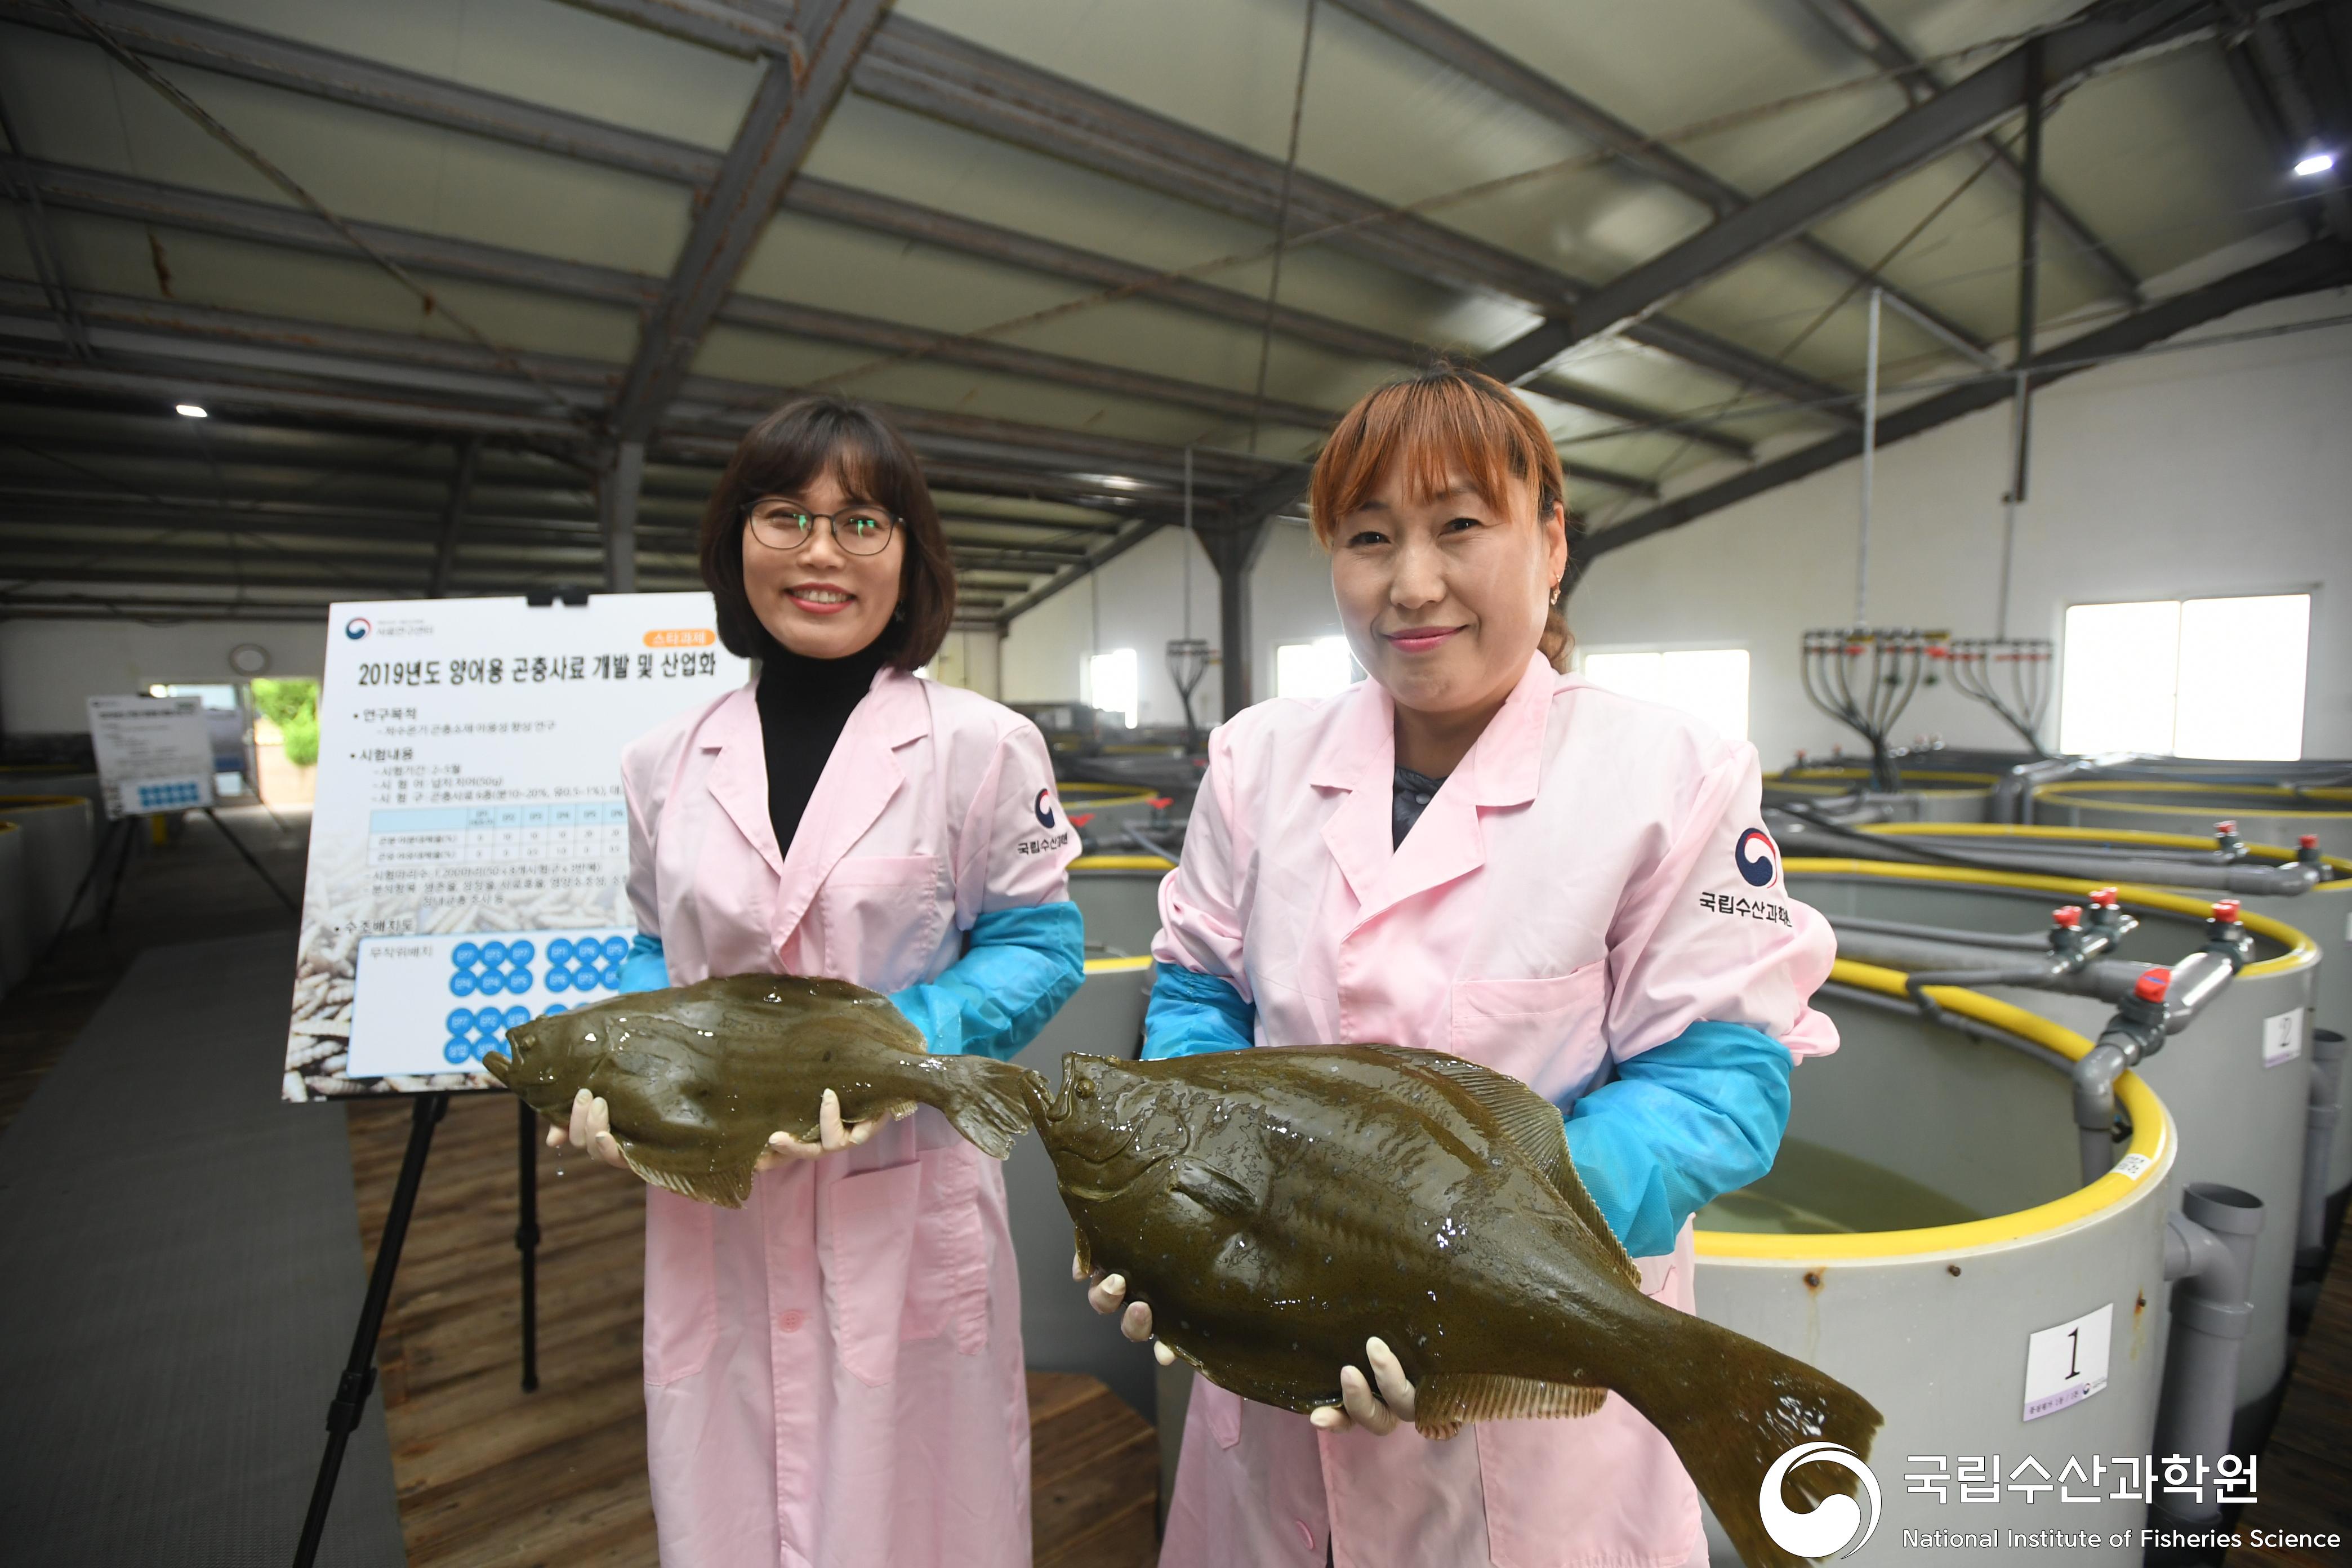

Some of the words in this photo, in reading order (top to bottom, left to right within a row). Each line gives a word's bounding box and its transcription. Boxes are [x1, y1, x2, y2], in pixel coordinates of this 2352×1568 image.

[653, 632, 705, 645] 스타과제
[358, 660, 440, 685] 2019년도
[450, 658, 503, 685] 양어용
[512, 656, 585, 682] 곤충사료
[593, 654, 629, 679] 개발
[638, 653, 652, 678] 및
[662, 651, 716, 676] 산업화
[360, 747, 413, 761] 시험내용
[2279, 1017, 2292, 1047] 2
[2065, 1327, 2081, 1380] 1
